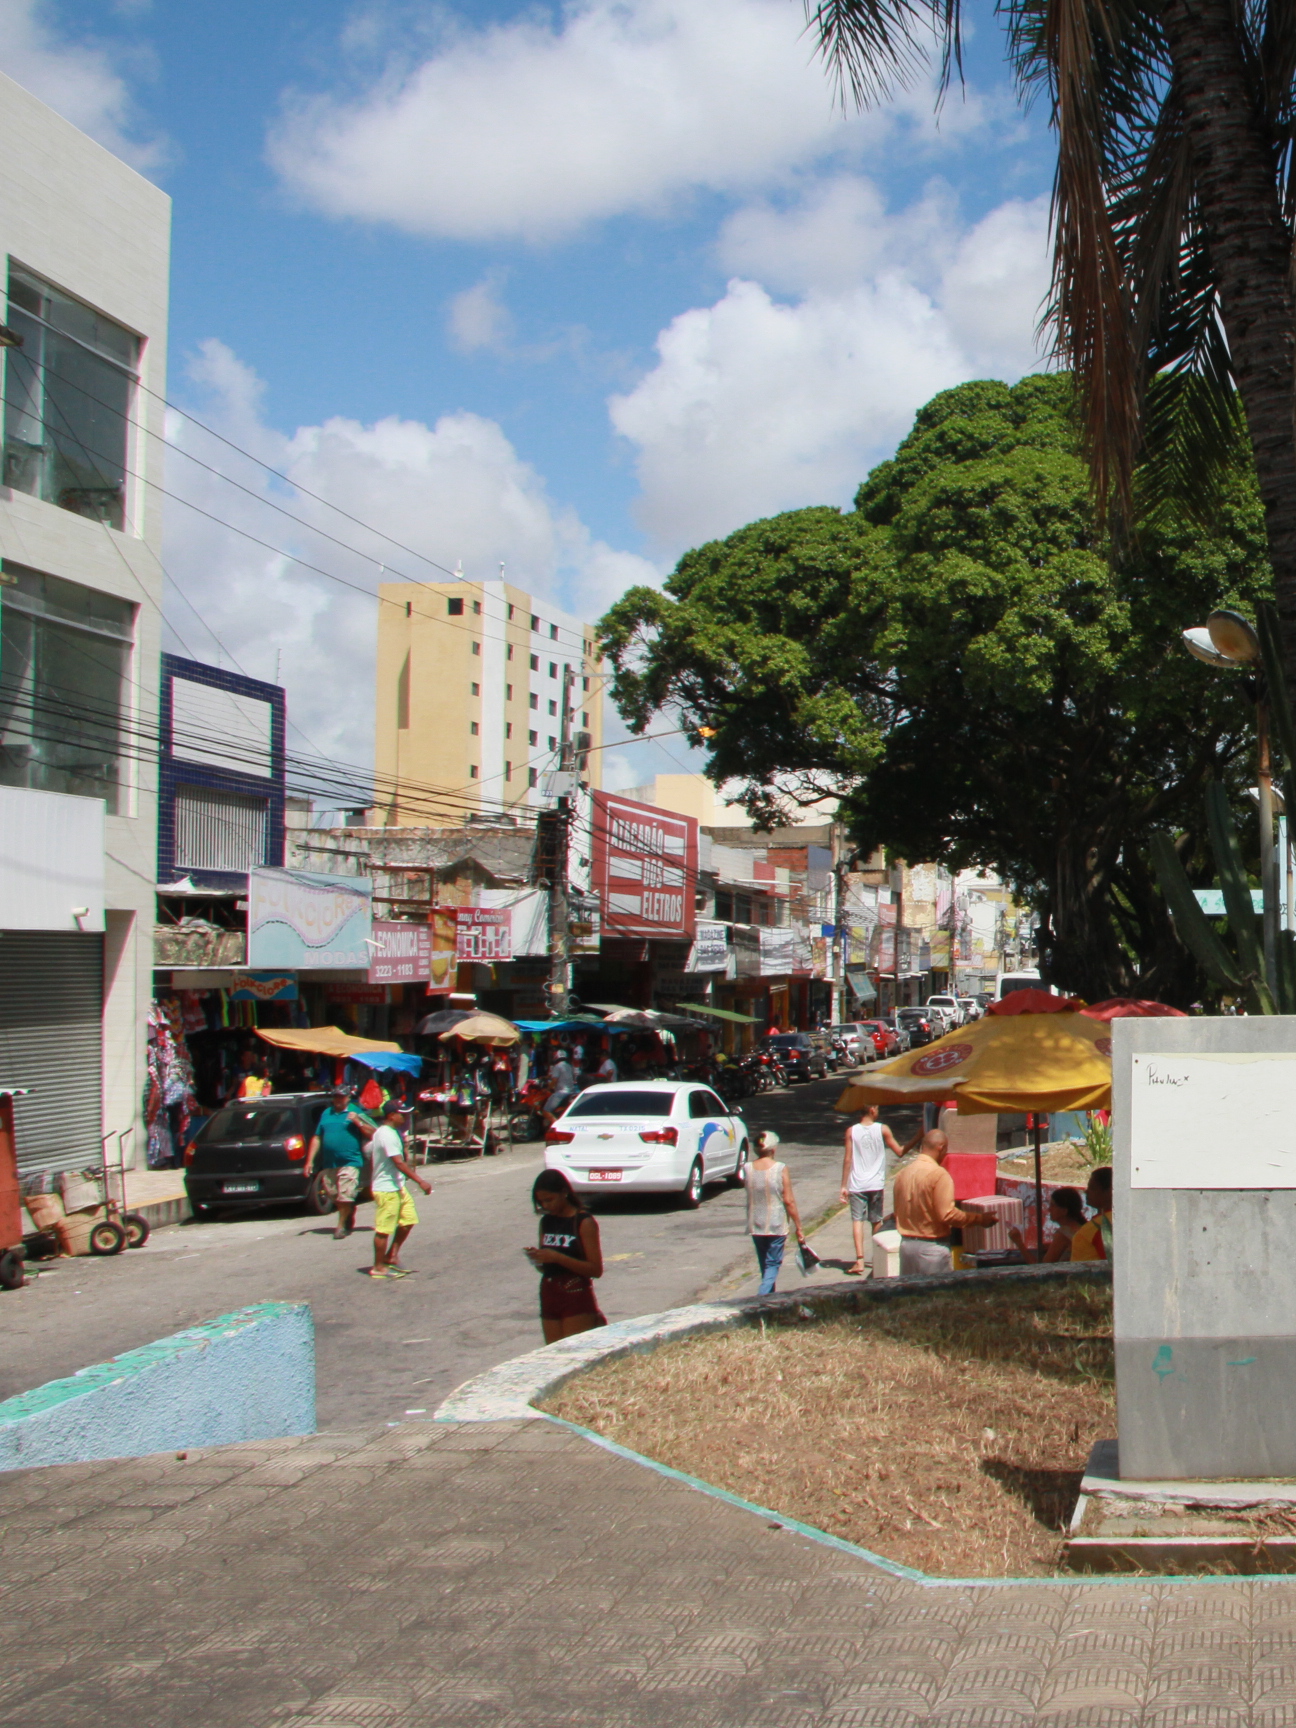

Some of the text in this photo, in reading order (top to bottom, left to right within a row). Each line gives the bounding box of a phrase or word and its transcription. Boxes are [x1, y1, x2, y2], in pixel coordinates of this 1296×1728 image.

[644, 858, 664, 888] DOS
[643, 891, 683, 922] ELETROS
[304, 951, 369, 966] MODAS
[375, 966, 392, 978] 3223
[398, 965, 413, 977] 1183
